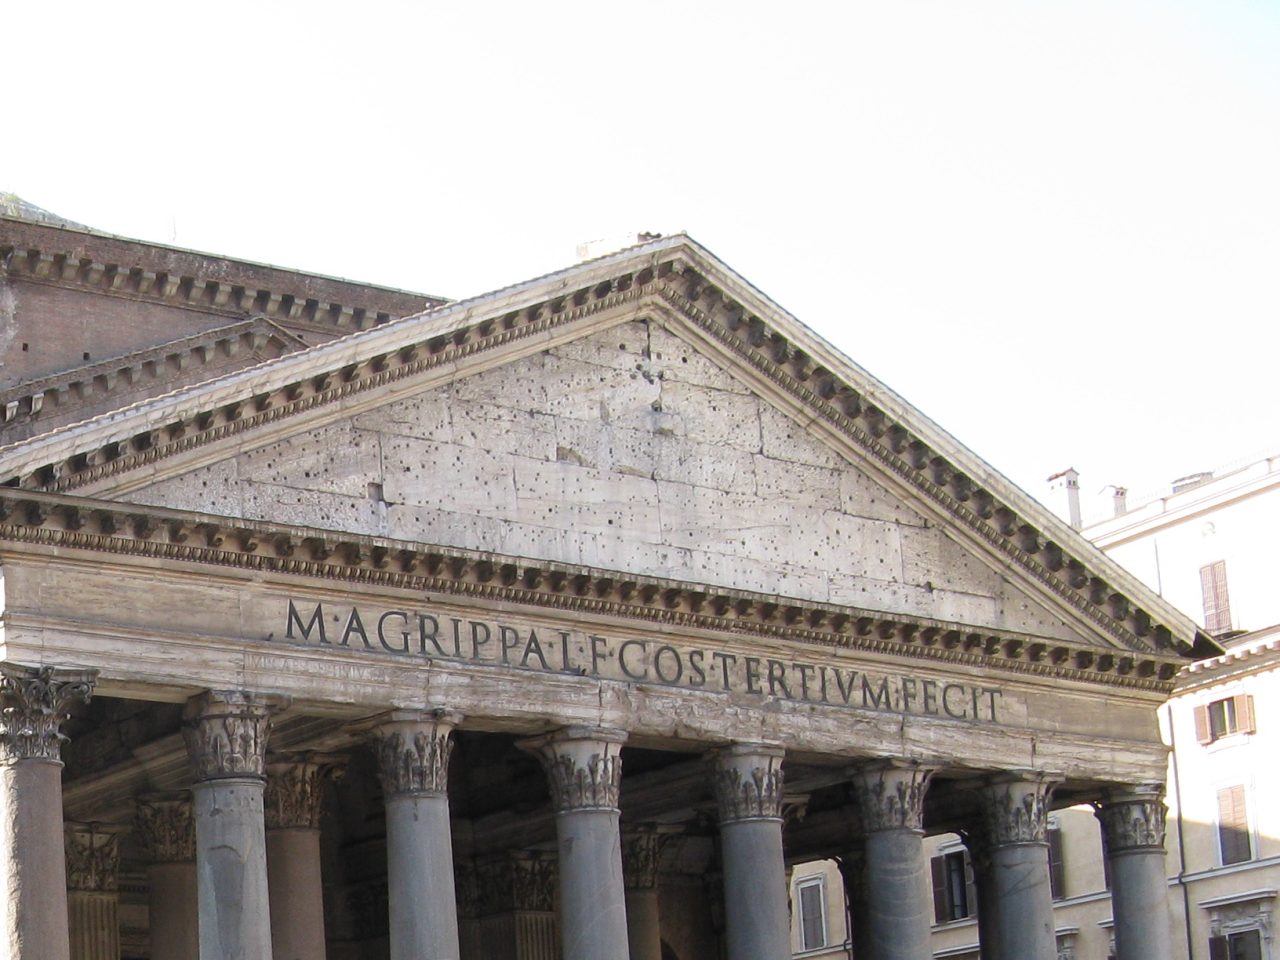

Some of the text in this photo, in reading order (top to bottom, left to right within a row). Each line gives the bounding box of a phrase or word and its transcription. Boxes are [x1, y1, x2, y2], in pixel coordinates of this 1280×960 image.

[337, 606, 553, 671] AGRIPPA
[619, 639, 707, 687] COS
[712, 651, 892, 713] TERTIVM
[900, 676, 1003, 723] FECIT
